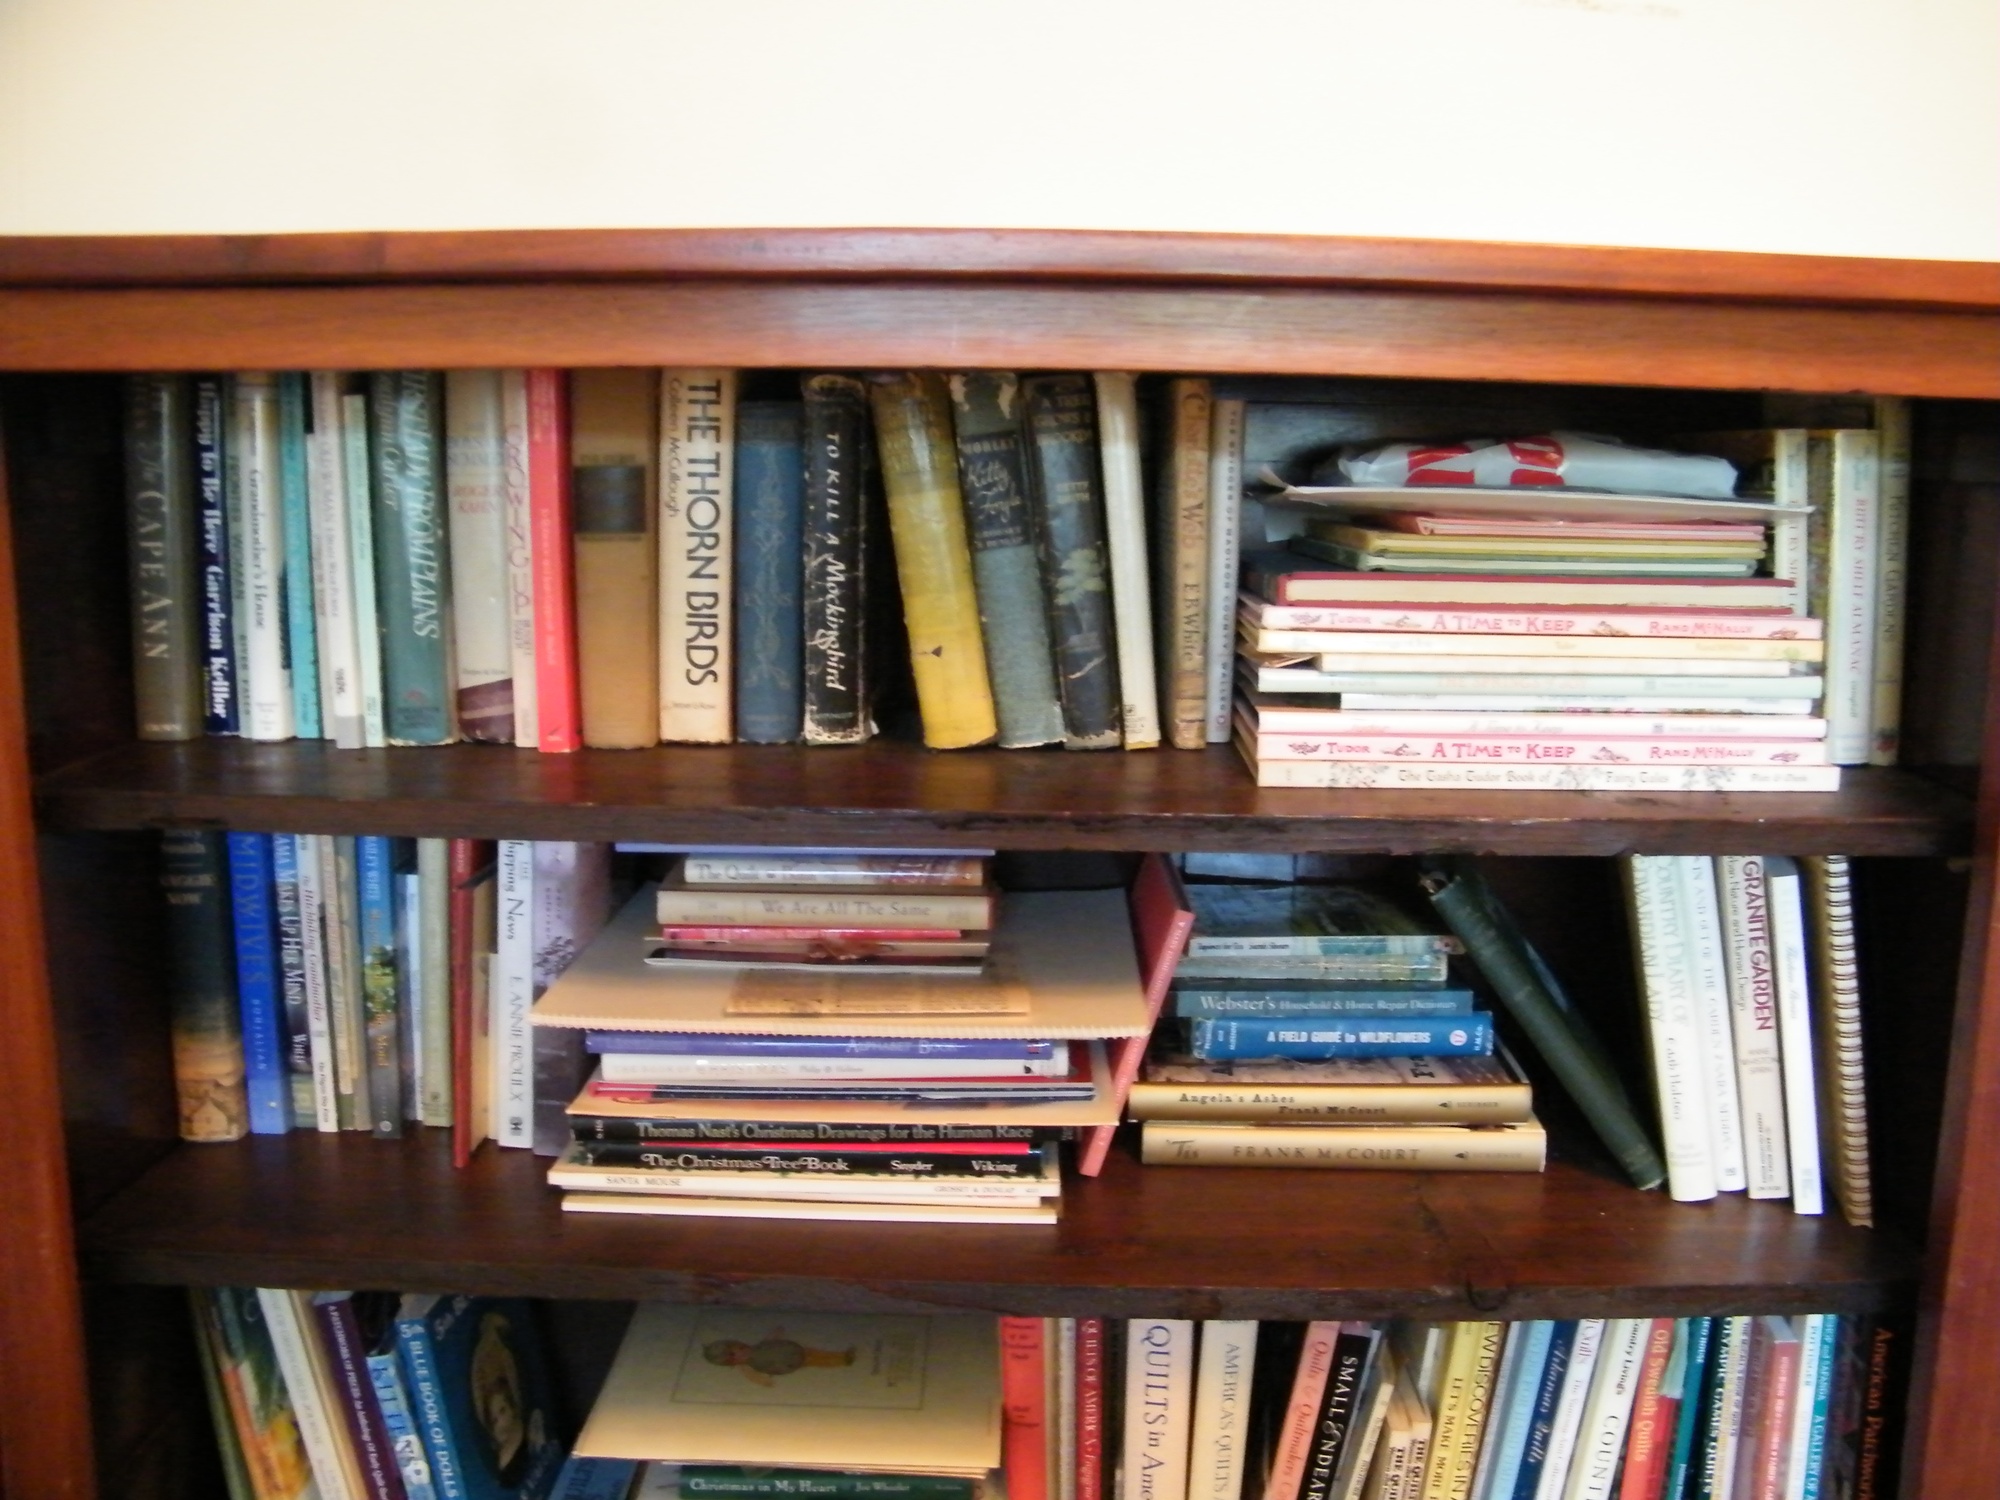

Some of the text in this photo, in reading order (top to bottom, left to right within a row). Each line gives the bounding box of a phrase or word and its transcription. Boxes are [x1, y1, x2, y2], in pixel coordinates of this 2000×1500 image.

[196, 383, 221, 554] Happy Be Here
[665, 378, 681, 518] Colleen McCullough
[229, 455, 245, 600] FRONTIER WOMAN
[248, 469, 266, 578] Grandmother's
[686, 379, 721, 686] THE THORN BIRDS
[1181, 501, 1204, 550] Web
[1885, 496, 1904, 562] KITCHEN
[137, 491, 173, 659] CAPE ANN
[816, 432, 846, 690] TO KILL A Mockingbird
[1219, 410, 1237, 711] THE BRIDGES OF MADISON COUNTY WALLER
[207, 565, 224, 650] Garrison
[252, 585, 268, 629] House
[410, 558, 440, 639] PLAINS
[1432, 614, 1447, 630] A
[1454, 615, 1502, 630] TIME
[1525, 616, 1575, 632] KEEP
[1649, 621, 1688, 633] RAND
[1327, 742, 1755, 758] TUDOR A TIME KEEP RAND McNALLY
[1398, 770, 1535, 782] The Tasha Tudor Book
[365, 836, 379, 868] BAILEY
[520, 861, 529, 881] THE
[232, 836, 269, 984] MIDWIVES
[366, 870, 380, 901] WHITE
[761, 899, 931, 916] We Are All The Same
[507, 898, 524, 940] News
[1728, 882, 1750, 1012] Nature and Human Design
[1742, 860, 1774, 1031] GRANITE GARDEN
[275, 869, 308, 1065] MAKES UP HER MIND WHITE
[303, 889, 323, 1023] Hitchhiking Grandmother
[1664, 944, 1689, 1027] DIARY OF
[1694, 888, 1721, 1049] AND THE GARDEN
[1199, 994, 1408, 1012] Webster's Household & Home Repair
[1642, 971, 1665, 1024] LADY
[509, 976, 524, 1102] E. ANNIE PROULX
[1266, 1032, 1431, 1044] A FIELD GUIDE WILDFLOWERS
[1178, 1092, 1296, 1106] Angela's Ashes
[1277, 1105, 1387, 1115] Frank McCourt
[634, 1121, 1034, 1142] Thomas Nast's Christmas Drawings for the Human Race
[1232, 1146, 1306, 1160] FRANK
[640, 1153, 1018, 1174] The Christmas Tree Book Snyder Viking
[644, 1176, 682, 1187] MOUSE
[330, 1311, 350, 1359] PATCHWORK
[410, 1341, 429, 1378] BLUE
[1803, 1325, 1818, 1387] POTTINGER
[417, 1382, 440, 1422] BOOK
[1141, 1325, 1171, 1426] QUILTS
[1328, 1356, 1359, 1417] SMALL
[1539, 1340, 1567, 1413] Arkansas
[1615, 1359, 1635, 1396] Living's
[1634, 1329, 1668, 1462] Old Swedish Quilts
[1701, 1317, 1733, 1494] OLYMPIC GAMES QUILTS
[429, 1427, 445, 1443] OF
[1084, 1388, 1098, 1446] AMERICA
[1146, 1431, 1165, 1448] in
[1213, 1343, 1241, 1492] AMERICA'S QUILTS
[1284, 1340, 1330, 1478] Quilts Quiltmakers
[1433, 1378, 1463, 1489] LET'S MAKE MORE
[1453, 1356, 1493, 1492] DISCOVERIES IN
[1857, 1327, 1895, 1500] American Patchwork
[435, 1450, 460, 1498] DOLLS
[1414, 1439, 1427, 1464] THE
[1805, 1415, 1826, 1491] A GALLERY OF
[688, 1478, 912, 1495] Christmas in My Heart Joe Wheeler
